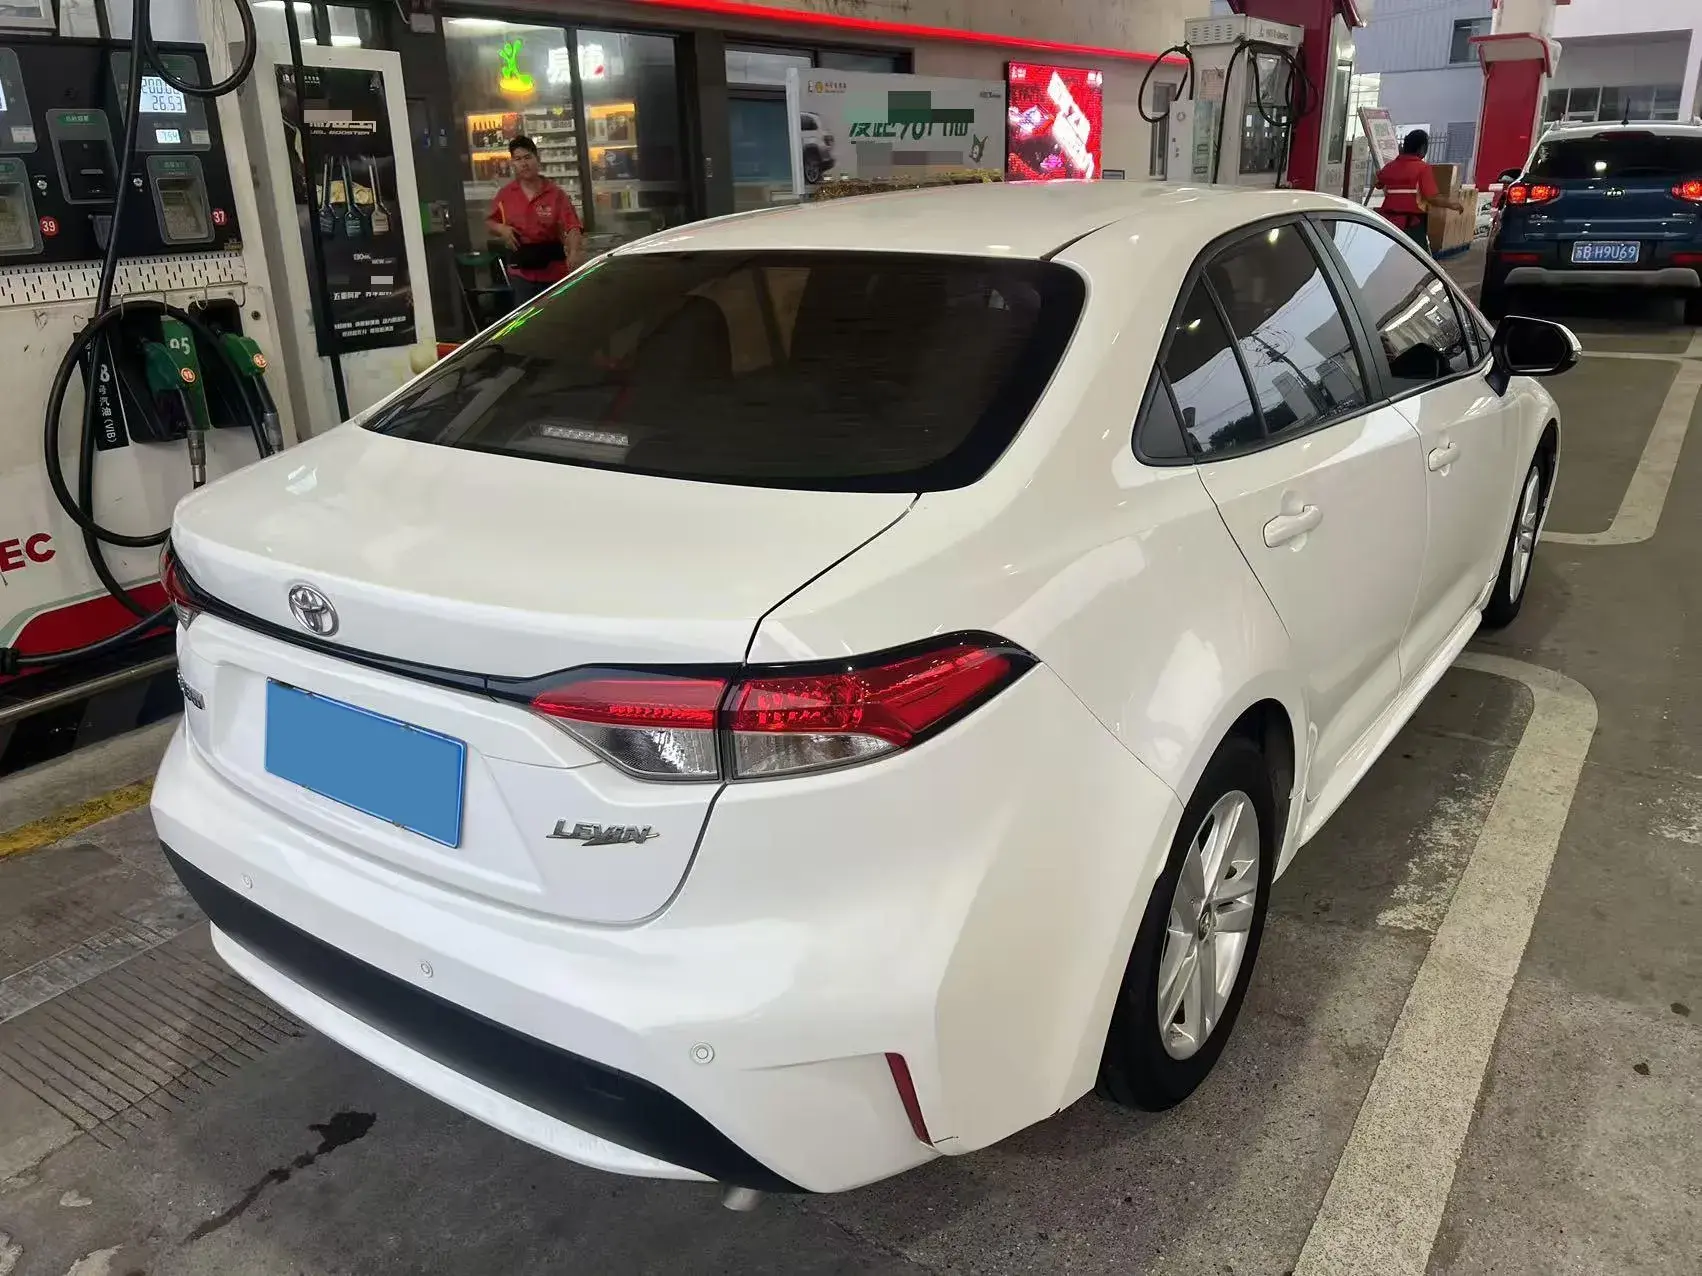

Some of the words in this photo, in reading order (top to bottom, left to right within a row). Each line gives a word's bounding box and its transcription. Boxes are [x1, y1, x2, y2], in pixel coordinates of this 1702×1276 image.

[213, 211, 225, 223] 37
[42, 220, 56, 232] 39
[169, 336, 191, 355] 95
[547, 818, 657, 846] LEVIN
